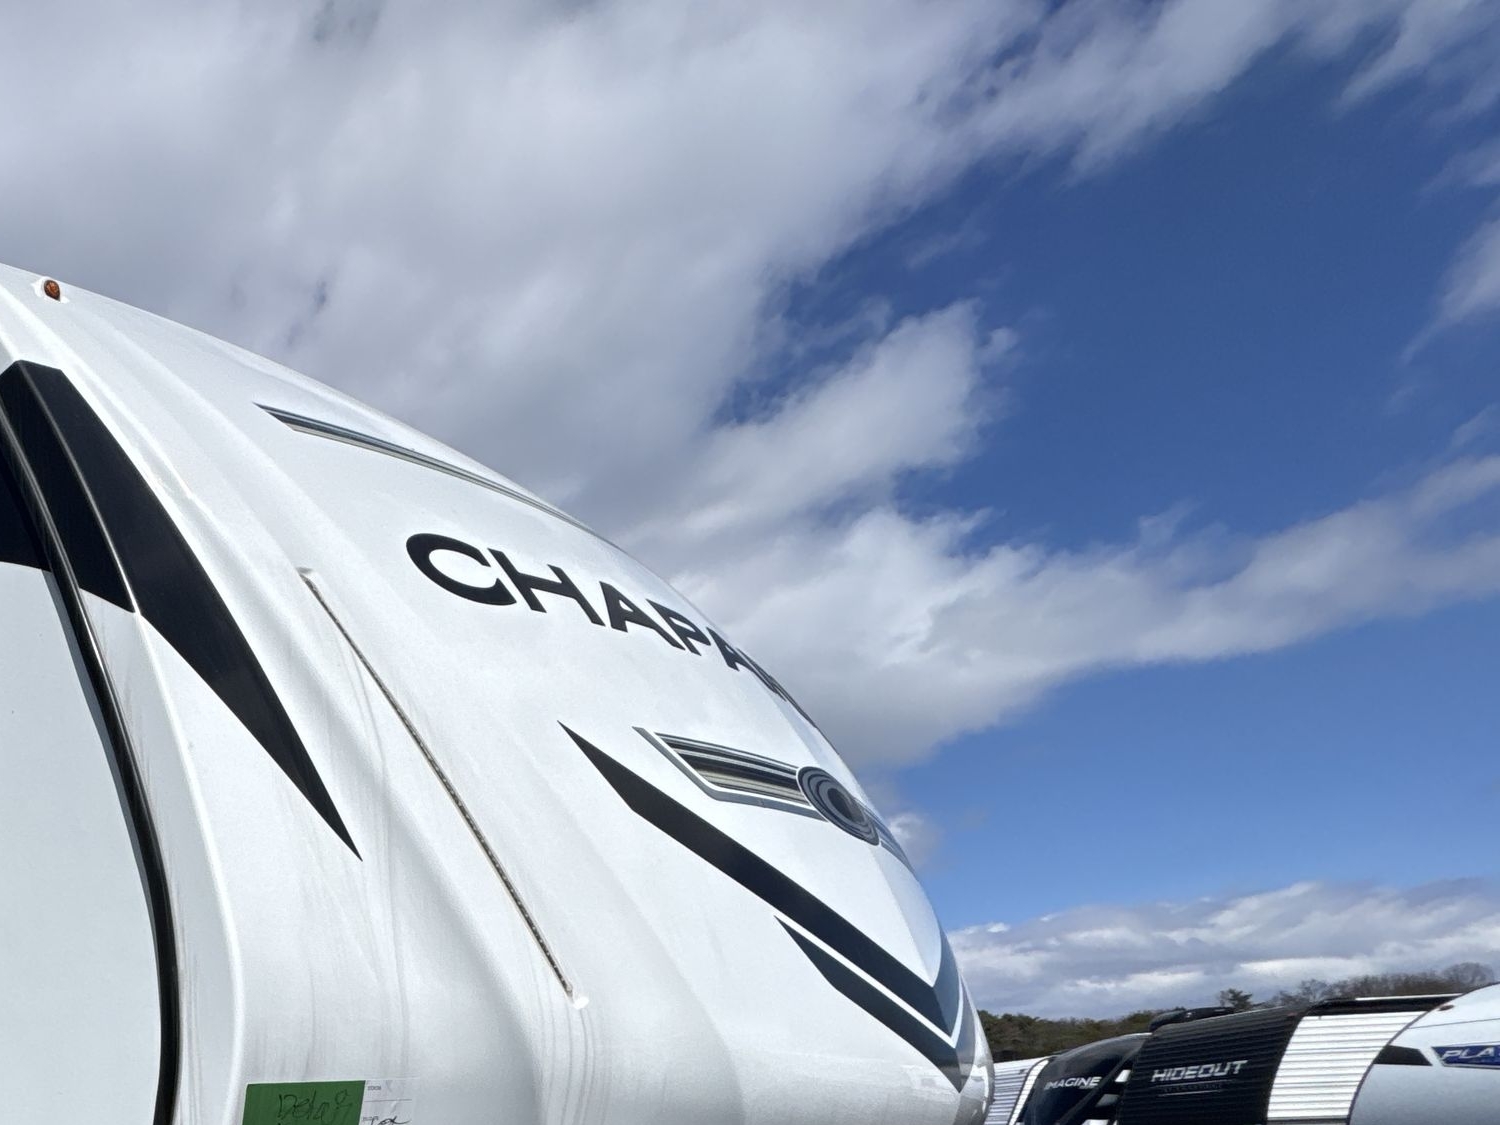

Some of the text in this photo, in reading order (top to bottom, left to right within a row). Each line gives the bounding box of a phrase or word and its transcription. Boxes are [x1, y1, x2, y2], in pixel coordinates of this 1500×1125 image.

[406, 533, 786, 702] CHAPA
[1441, 1047, 1500, 1060] PLA
[1151, 1060, 1248, 1082] HIDEOUT
[1044, 1076, 1102, 1091] IMAGINE
